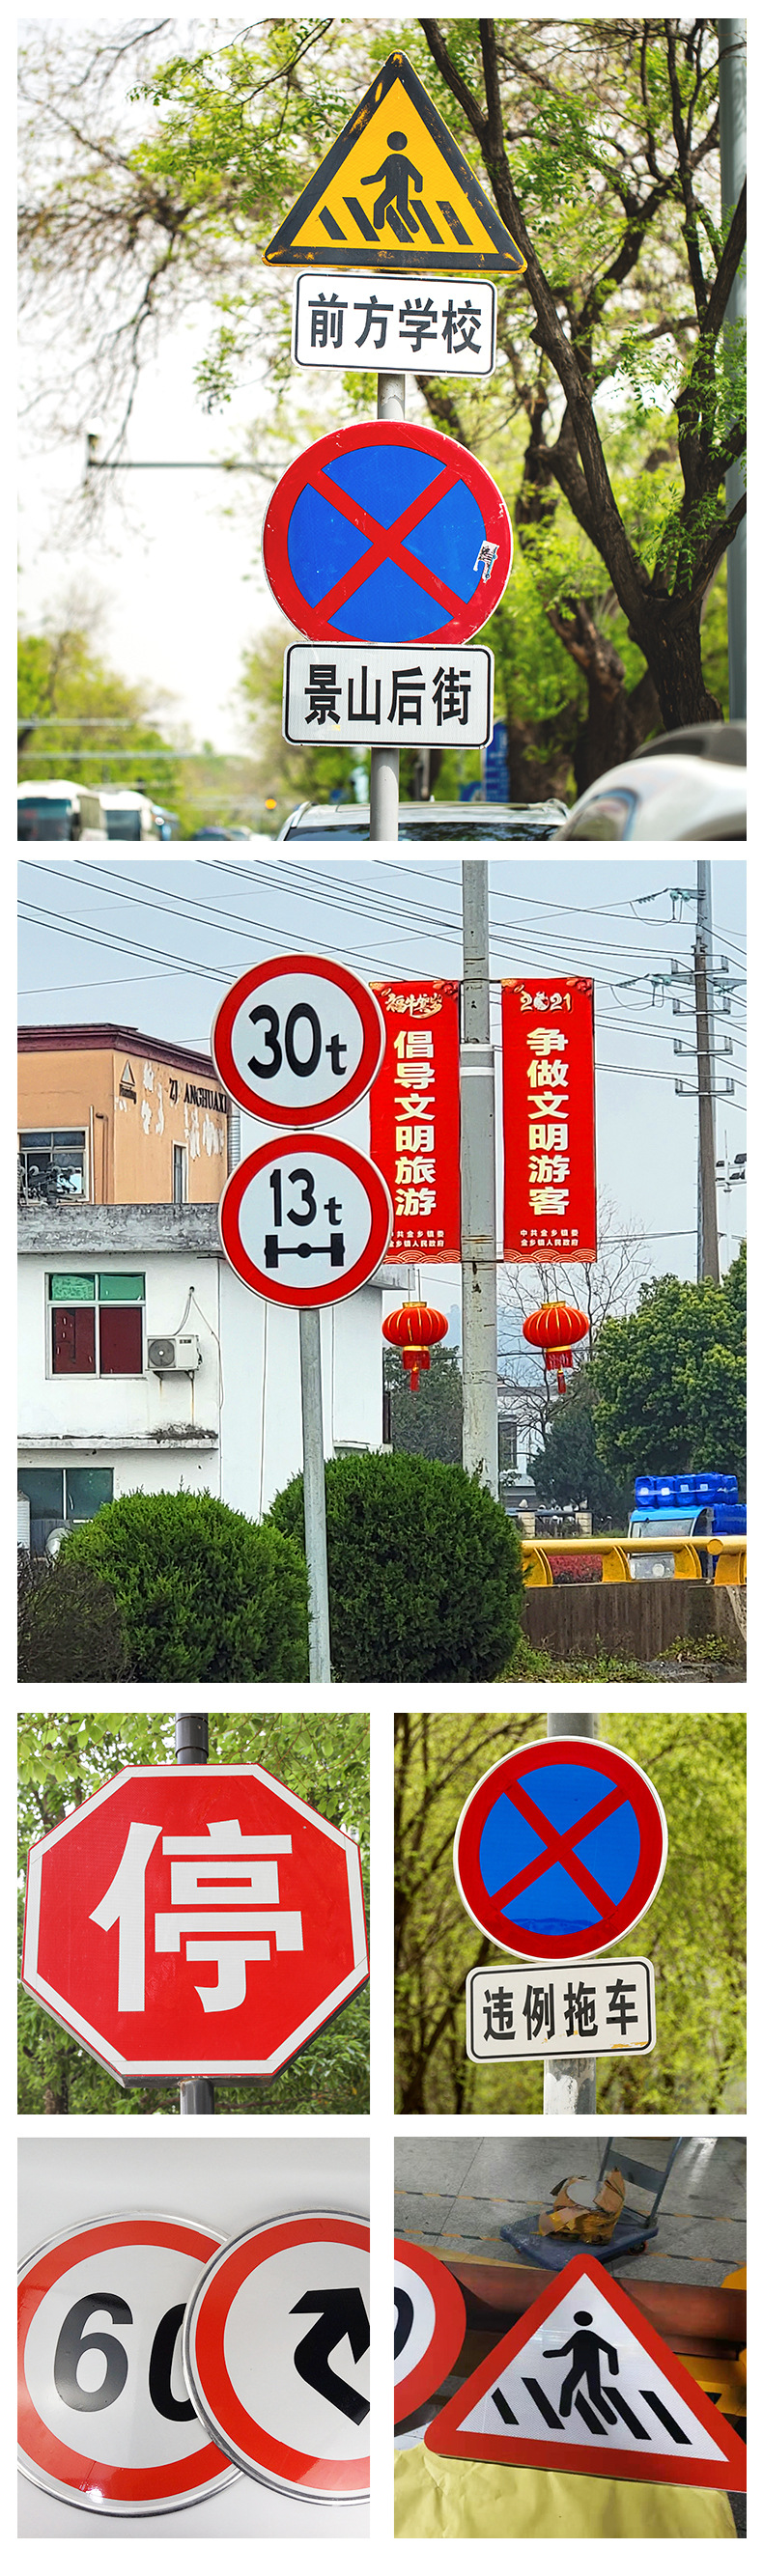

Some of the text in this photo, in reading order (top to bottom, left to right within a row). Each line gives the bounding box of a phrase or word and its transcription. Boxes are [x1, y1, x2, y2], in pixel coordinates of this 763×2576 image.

[308, 293, 482, 353] 前方学校
[304, 664, 471, 726] 景山后街
[521, 992, 572, 1011] 2021
[246, 1002, 348, 1078] 30t
[393, 1030, 437, 1217] 倡导文明旅游
[526, 1027, 570, 1216] 争做文明游客
[269, 1168, 343, 1227] 13t
[89, 1820, 304, 2014] 停
[482, 1977, 639, 2042] 违例拖车
